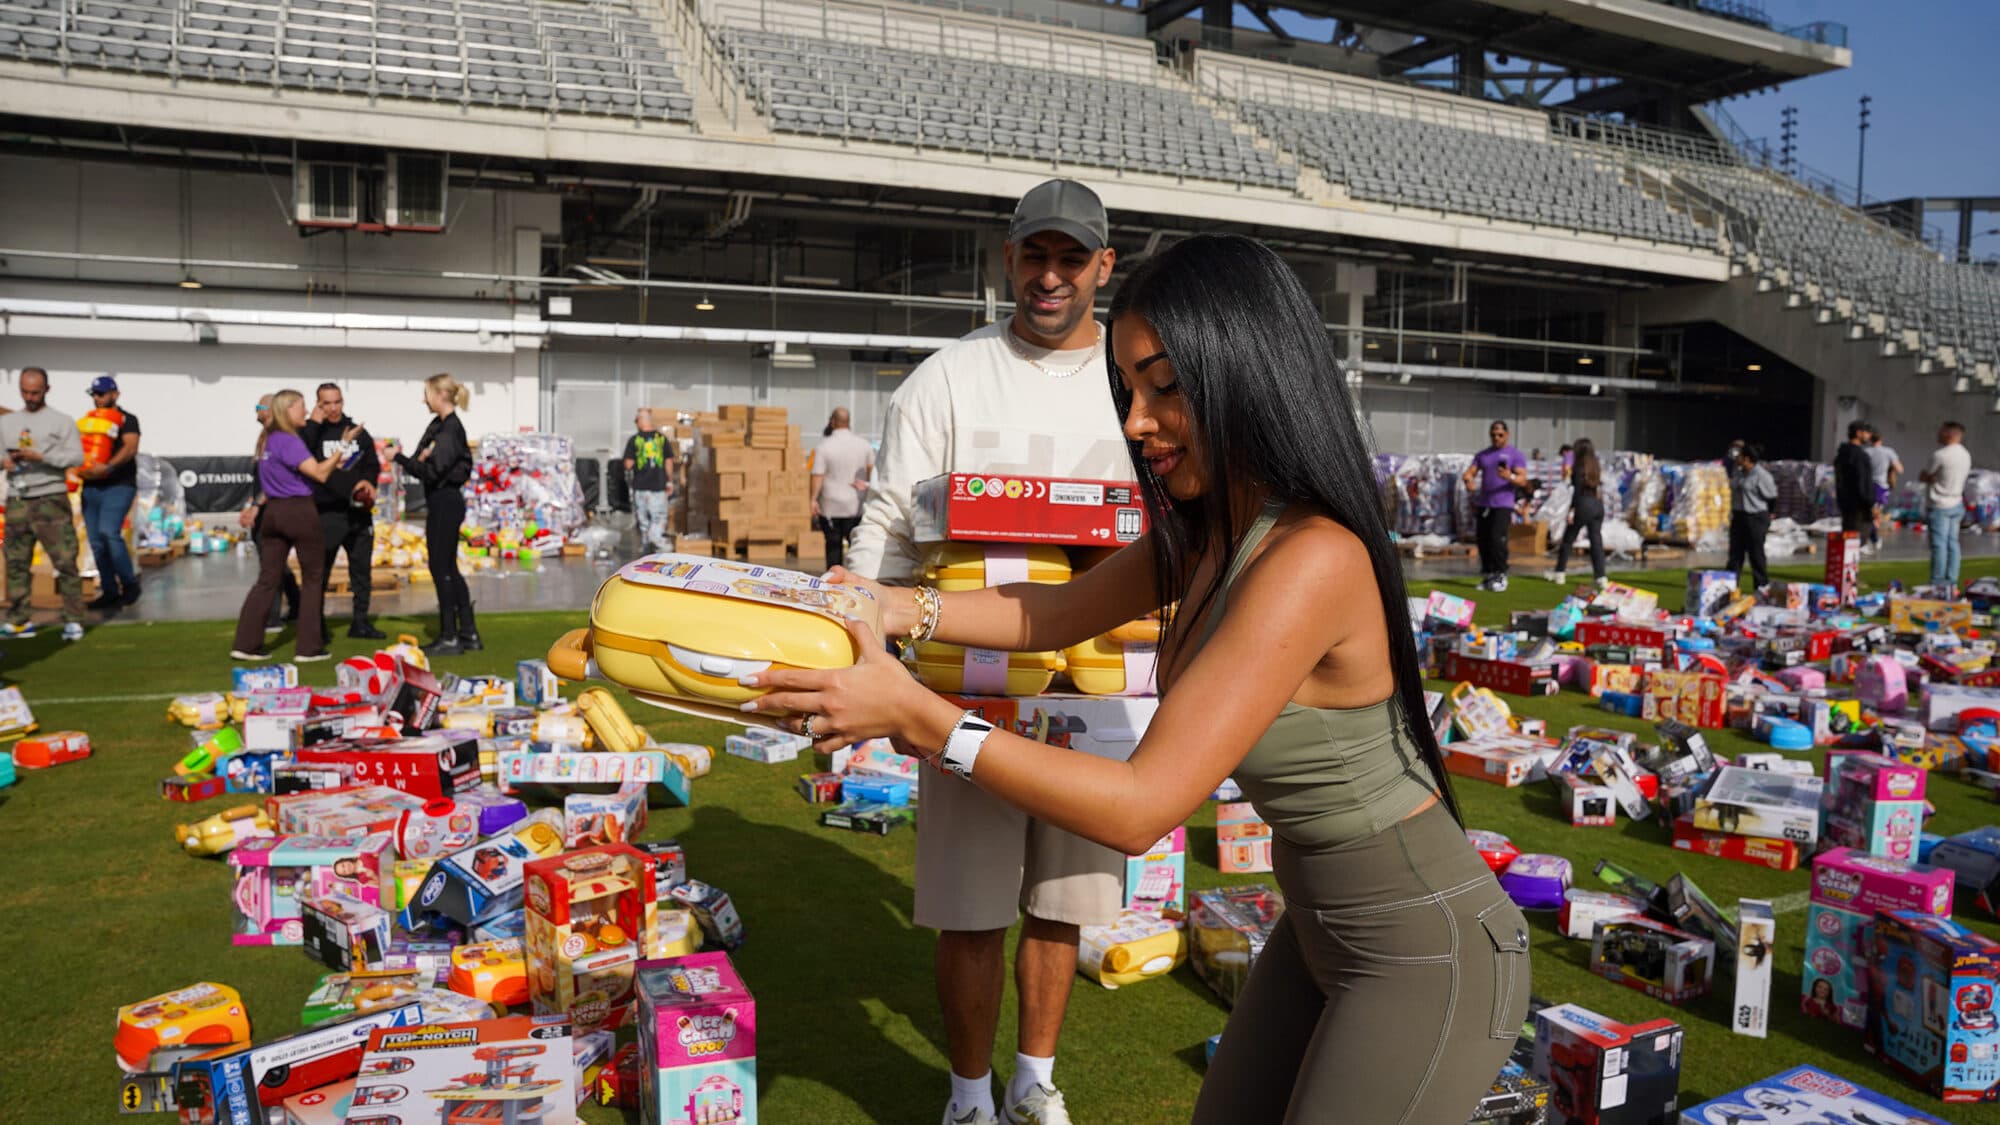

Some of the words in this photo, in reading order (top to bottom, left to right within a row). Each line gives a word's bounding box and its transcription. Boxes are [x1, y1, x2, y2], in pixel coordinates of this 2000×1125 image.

[198, 473, 254, 483] STADIUM
[1091, 528, 1111, 539] 6+
[355, 761, 419, 776] TYSO
[692, 1014, 721, 1031] ICE
[389, 1029, 474, 1044] TOP-NOTCH
[680, 1024, 735, 1045] CREAM
[689, 1041, 726, 1056] STOP
